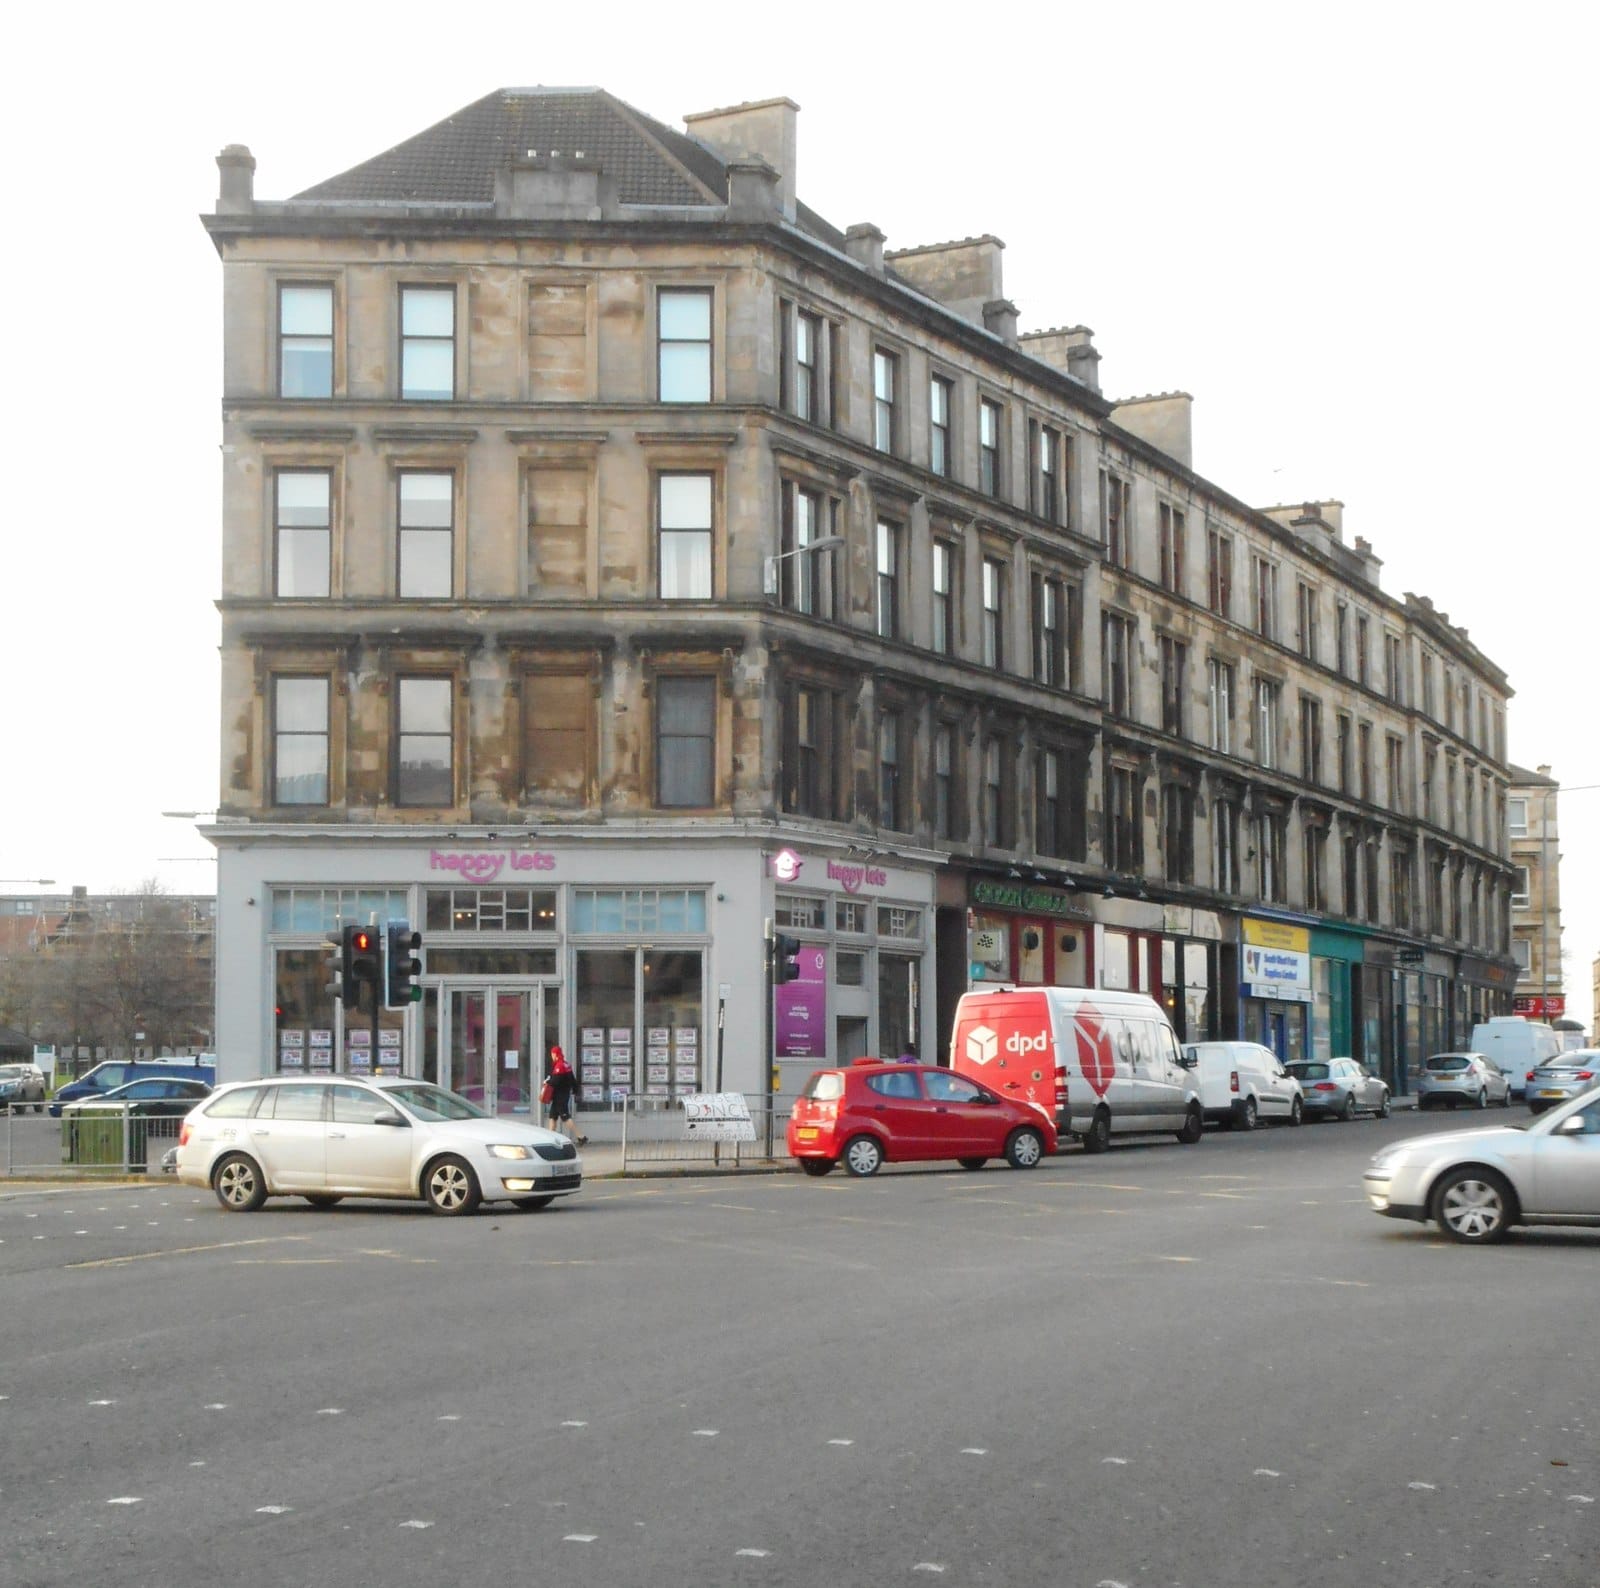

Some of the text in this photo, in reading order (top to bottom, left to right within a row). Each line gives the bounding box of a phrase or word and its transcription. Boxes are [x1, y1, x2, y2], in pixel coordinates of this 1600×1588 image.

[430, 848, 556, 885] happy lets
[827, 858, 887, 894] happy lets
[1005, 1030, 1048, 1057] dpd
